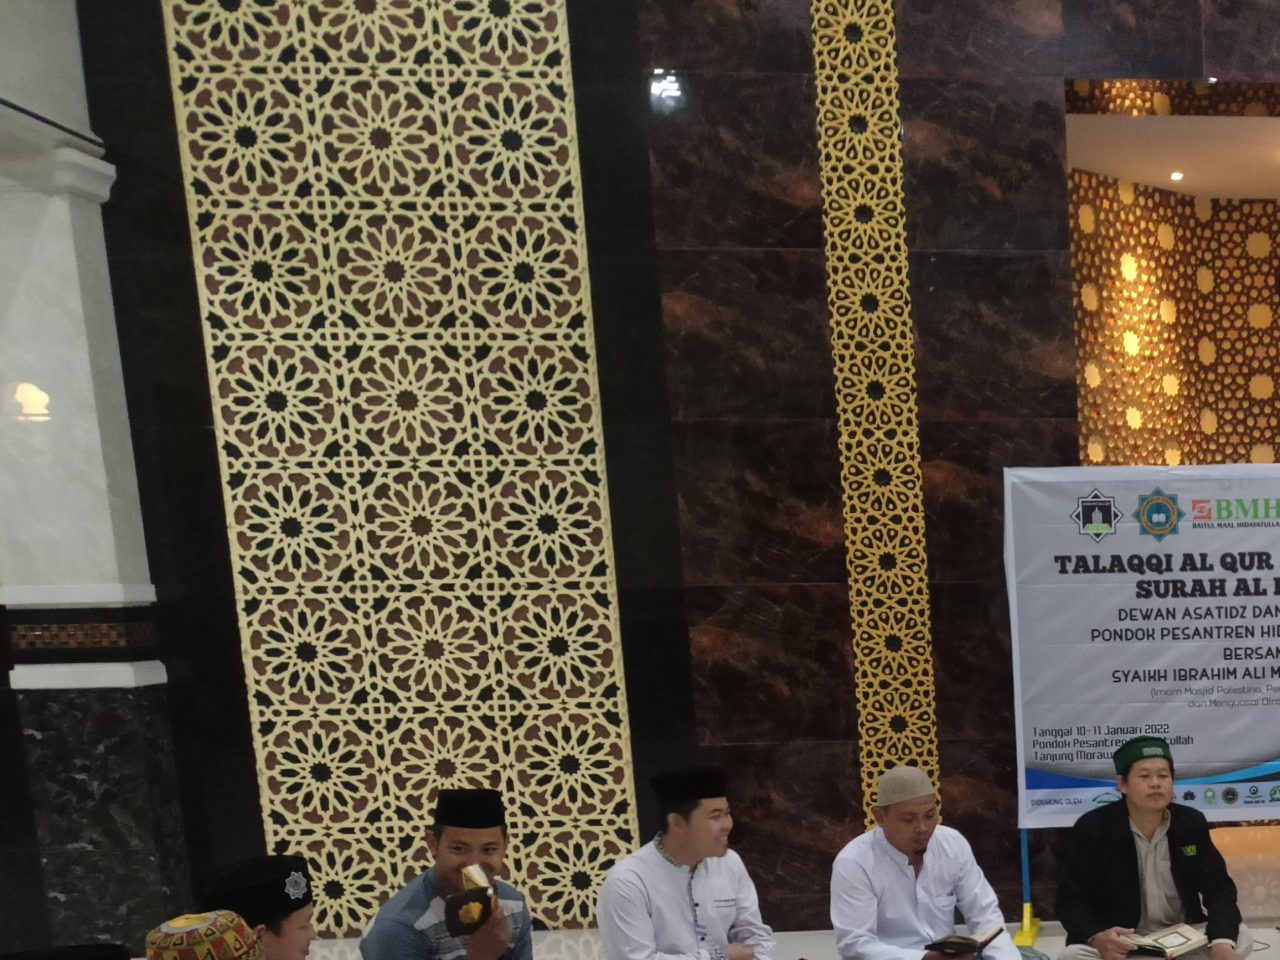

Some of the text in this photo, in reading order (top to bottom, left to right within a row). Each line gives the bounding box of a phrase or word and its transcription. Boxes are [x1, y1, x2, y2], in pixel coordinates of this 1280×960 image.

[1054, 553, 1173, 574] TALAQQI
[1179, 553, 1214, 572] AL
[1220, 552, 1274, 573] QUR
[1135, 578, 1227, 599] SURAH
[1233, 578, 1267, 596] AL
[1118, 607, 1176, 621] DEWAN
[1181, 606, 1247, 620] ASATIDZ
[1091, 628, 1156, 642] PONDOK
[1160, 625, 1255, 640] PESANTREN
[1111, 669, 1168, 683] SYAIKH
[1173, 667, 1237, 681] IBRAHIM
[1242, 666, 1266, 679] ALI
[1151, 688, 1182, 698] (Imam
[1184, 686, 1214, 697] Masjid
[1188, 698, 1206, 708] dan
[1209, 697, 1259, 709] Menguasai
[1033, 726, 1073, 739] Tanggal
[1104, 725, 1142, 736] Januari
[1144, 723, 1170, 734] 2022
[1033, 739, 1071, 749] Pondok
[1034, 751, 1074, 763] Tanjung
[1065, 797, 1083, 805] OLEH
